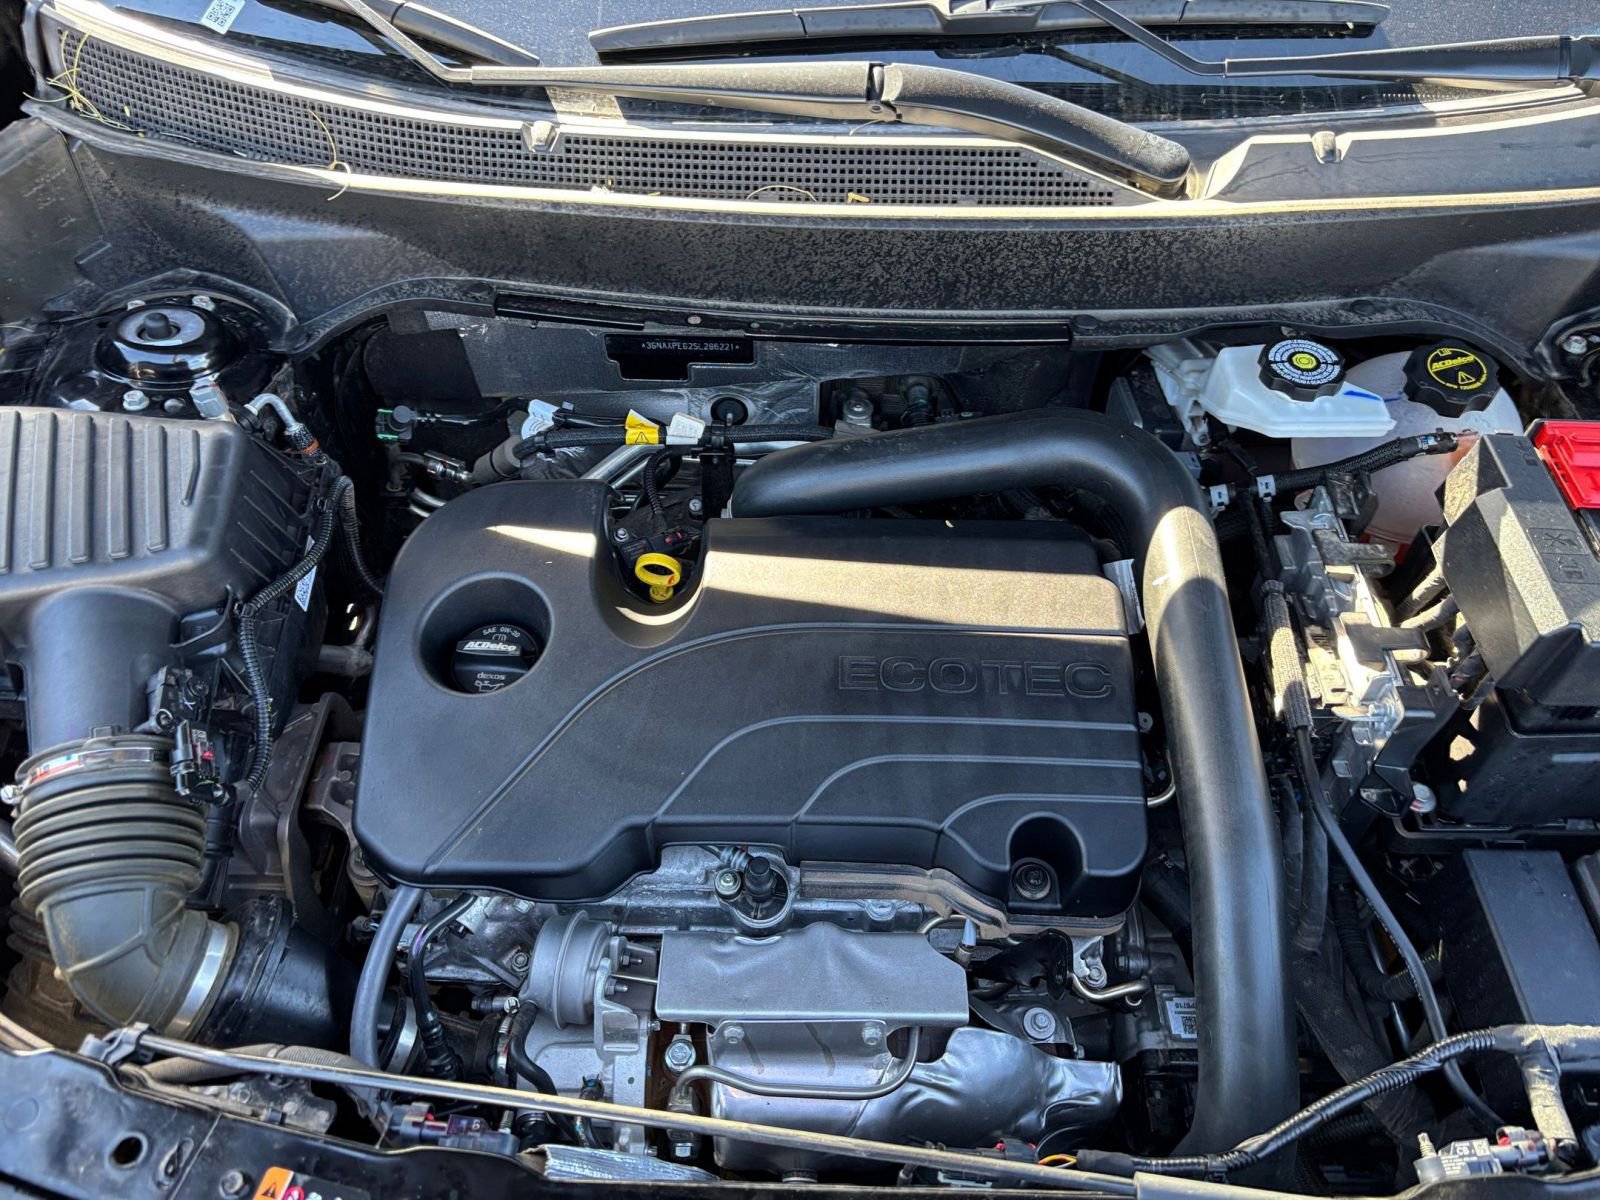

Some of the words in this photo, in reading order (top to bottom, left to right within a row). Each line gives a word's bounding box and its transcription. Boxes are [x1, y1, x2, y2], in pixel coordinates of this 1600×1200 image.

[483, 627, 497, 635] SAE
[500, 627, 520, 637] 0W-20
[463, 641, 517, 652] ACDelco
[477, 672, 506, 680] dexos
[838, 655, 1112, 699] ECOTEC
